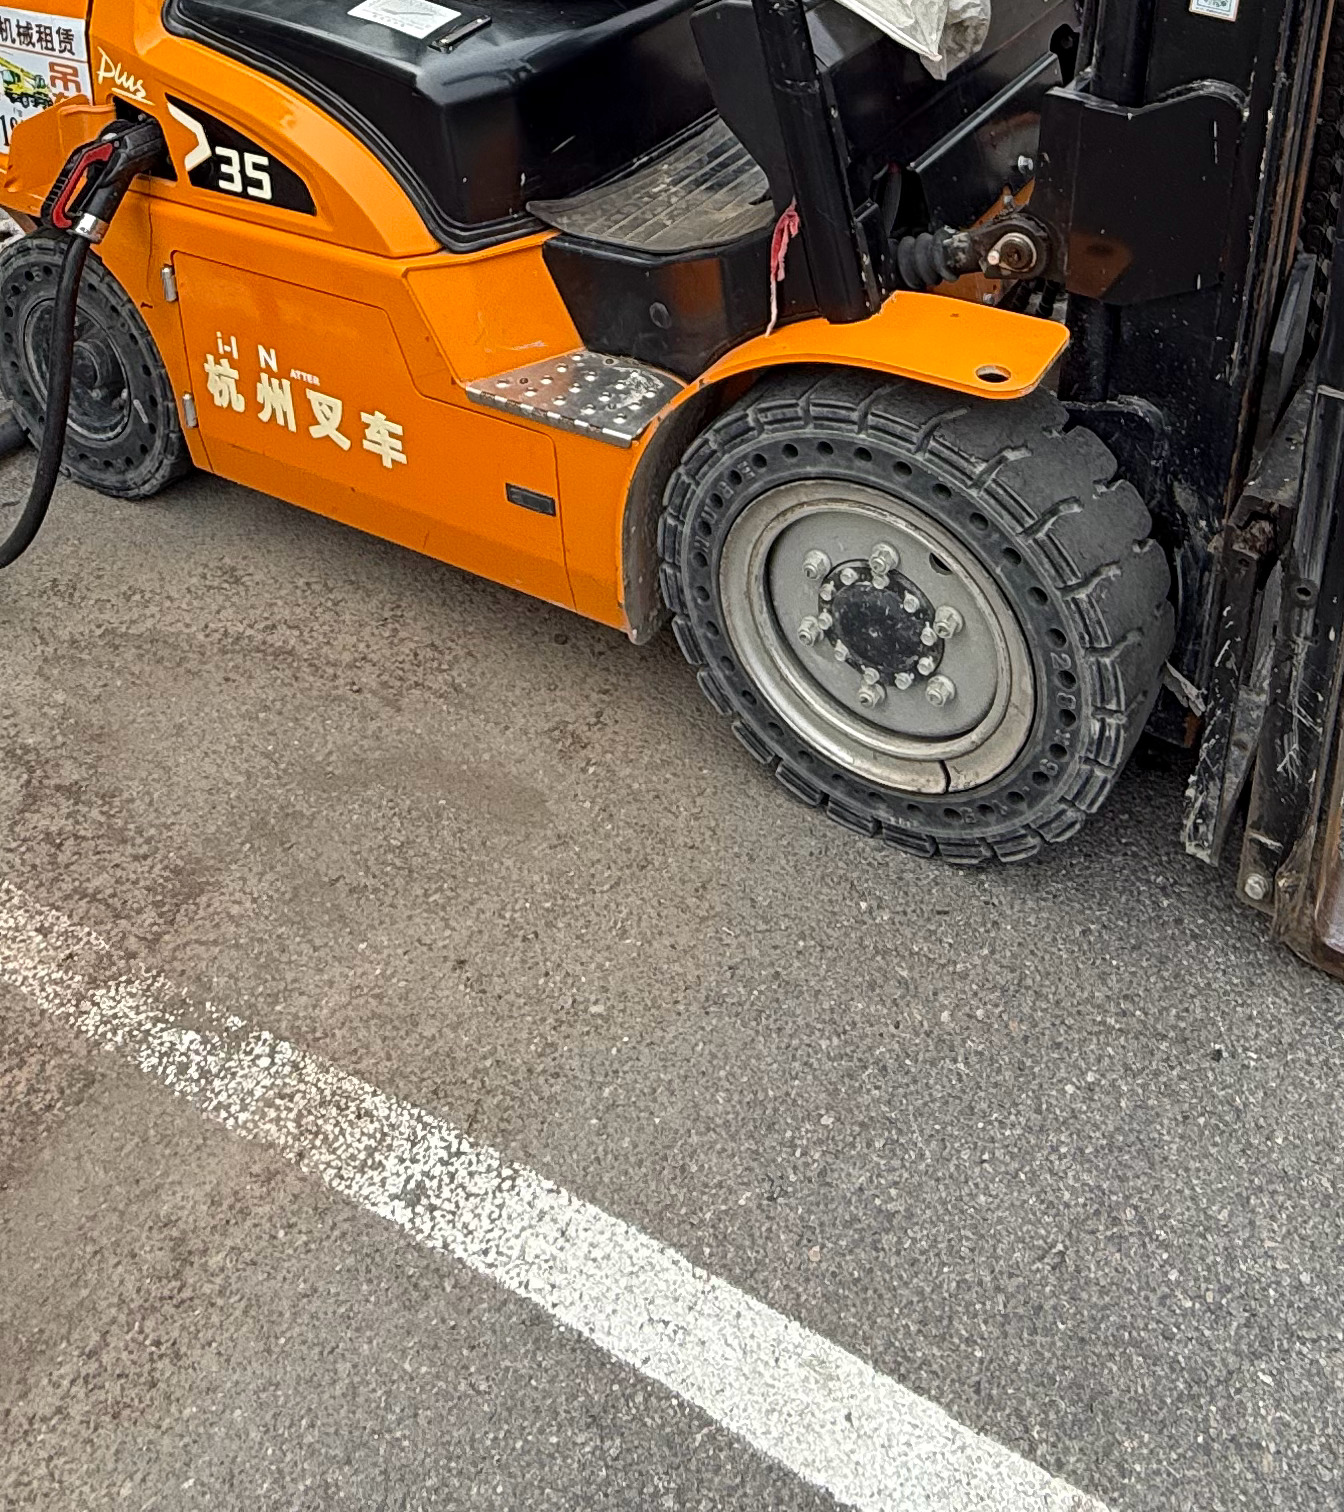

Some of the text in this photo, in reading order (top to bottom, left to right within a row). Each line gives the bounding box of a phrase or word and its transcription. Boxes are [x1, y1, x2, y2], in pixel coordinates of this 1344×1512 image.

[96, 46, 148, 99] Plus
[215, 145, 272, 201] 35
[204, 353, 408, 469] 杭州叉车
